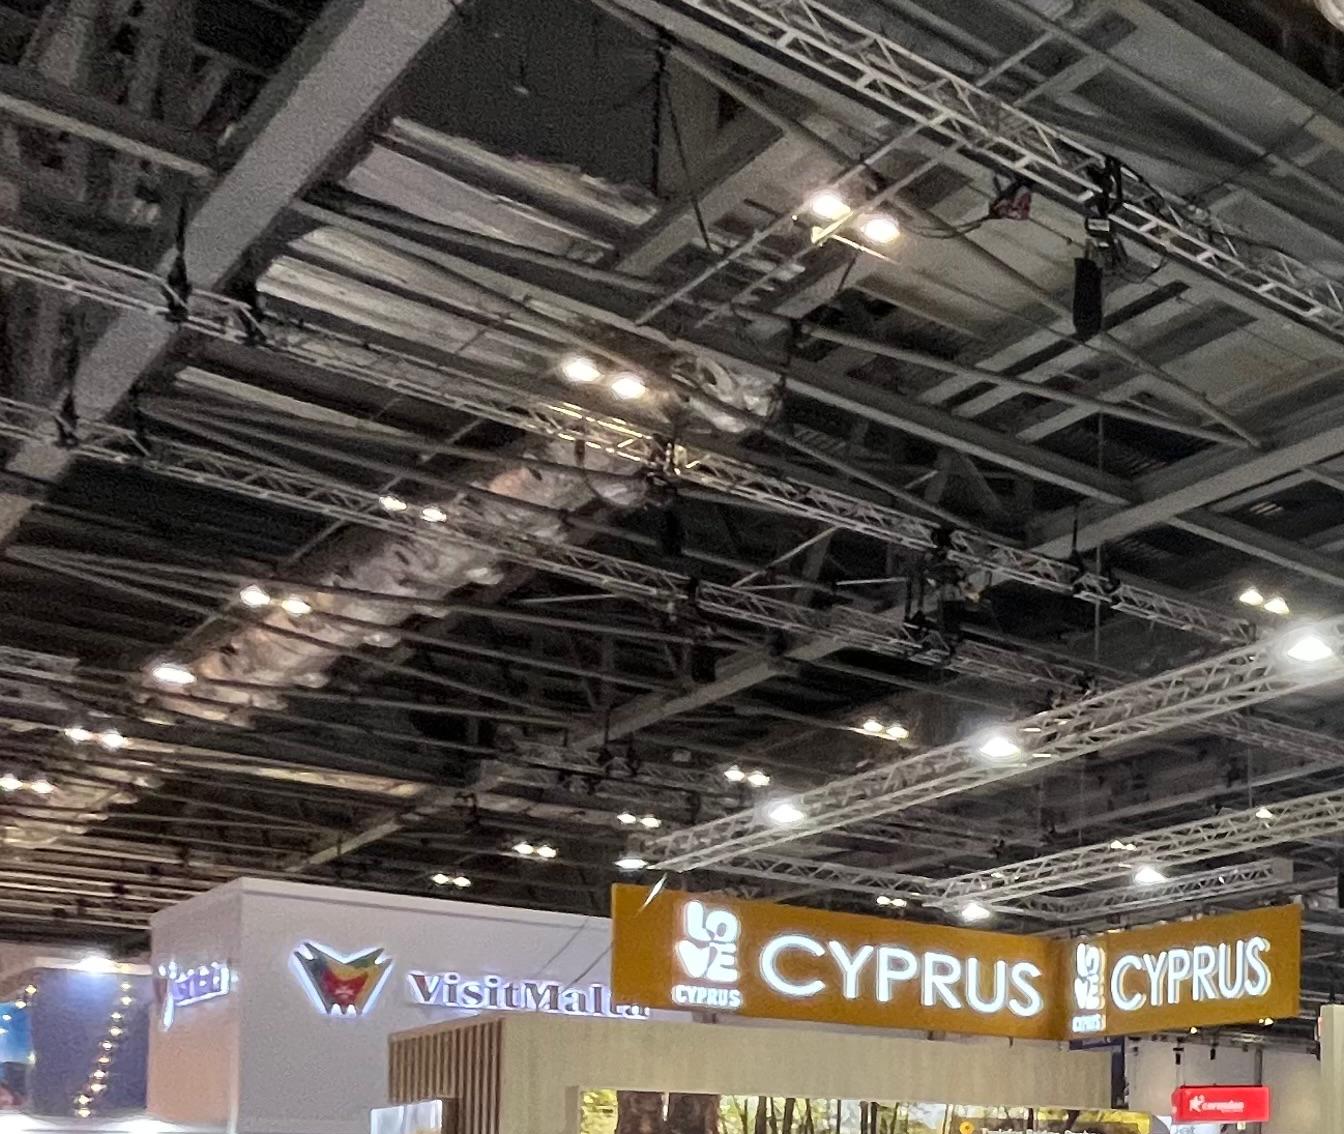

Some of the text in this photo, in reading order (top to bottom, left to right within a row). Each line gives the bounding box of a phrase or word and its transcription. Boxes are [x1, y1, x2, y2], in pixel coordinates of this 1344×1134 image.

[671, 985, 742, 1009] CYPRUS
[759, 934, 1045, 1017] CYPRUS
[1111, 936, 1270, 1011] CYPRUS
